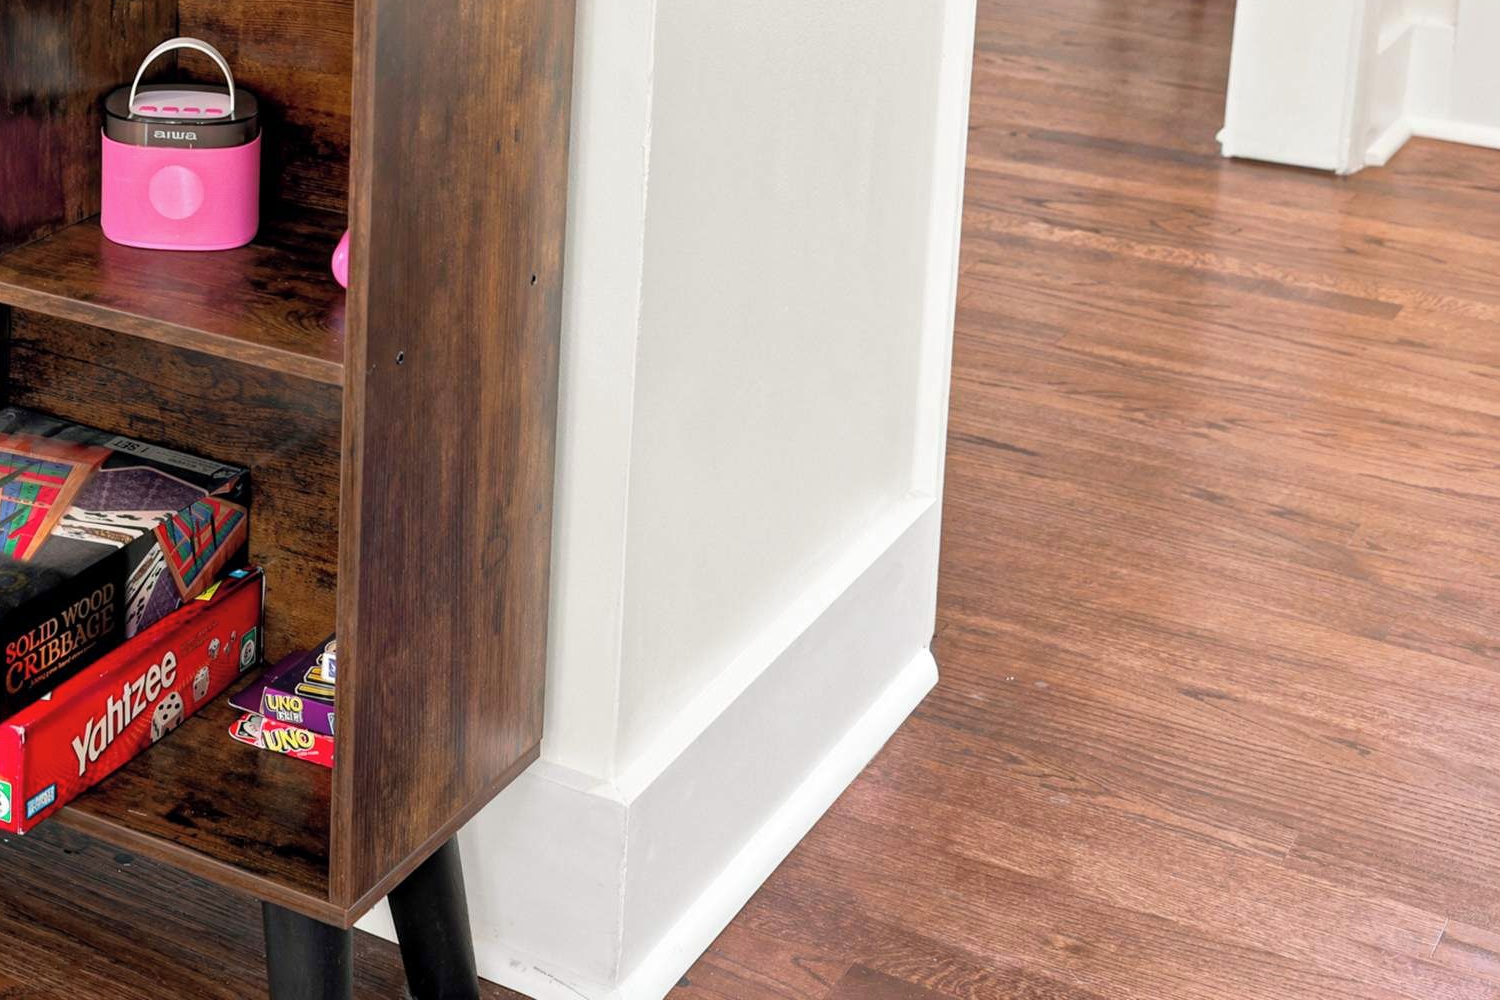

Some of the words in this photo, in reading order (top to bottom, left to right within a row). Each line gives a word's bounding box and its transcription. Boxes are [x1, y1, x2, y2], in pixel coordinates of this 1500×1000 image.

[153, 129, 197, 141] aiwa
[113, 440, 140, 451] SET
[5, 617, 59, 665] SOLID
[61, 582, 116, 628] WOOD
[5, 604, 116, 695] CRIBBAGE
[71, 650, 178, 777] Yahtzee
[265, 693, 304, 713] UNO
[262, 728, 315, 753] UNO
